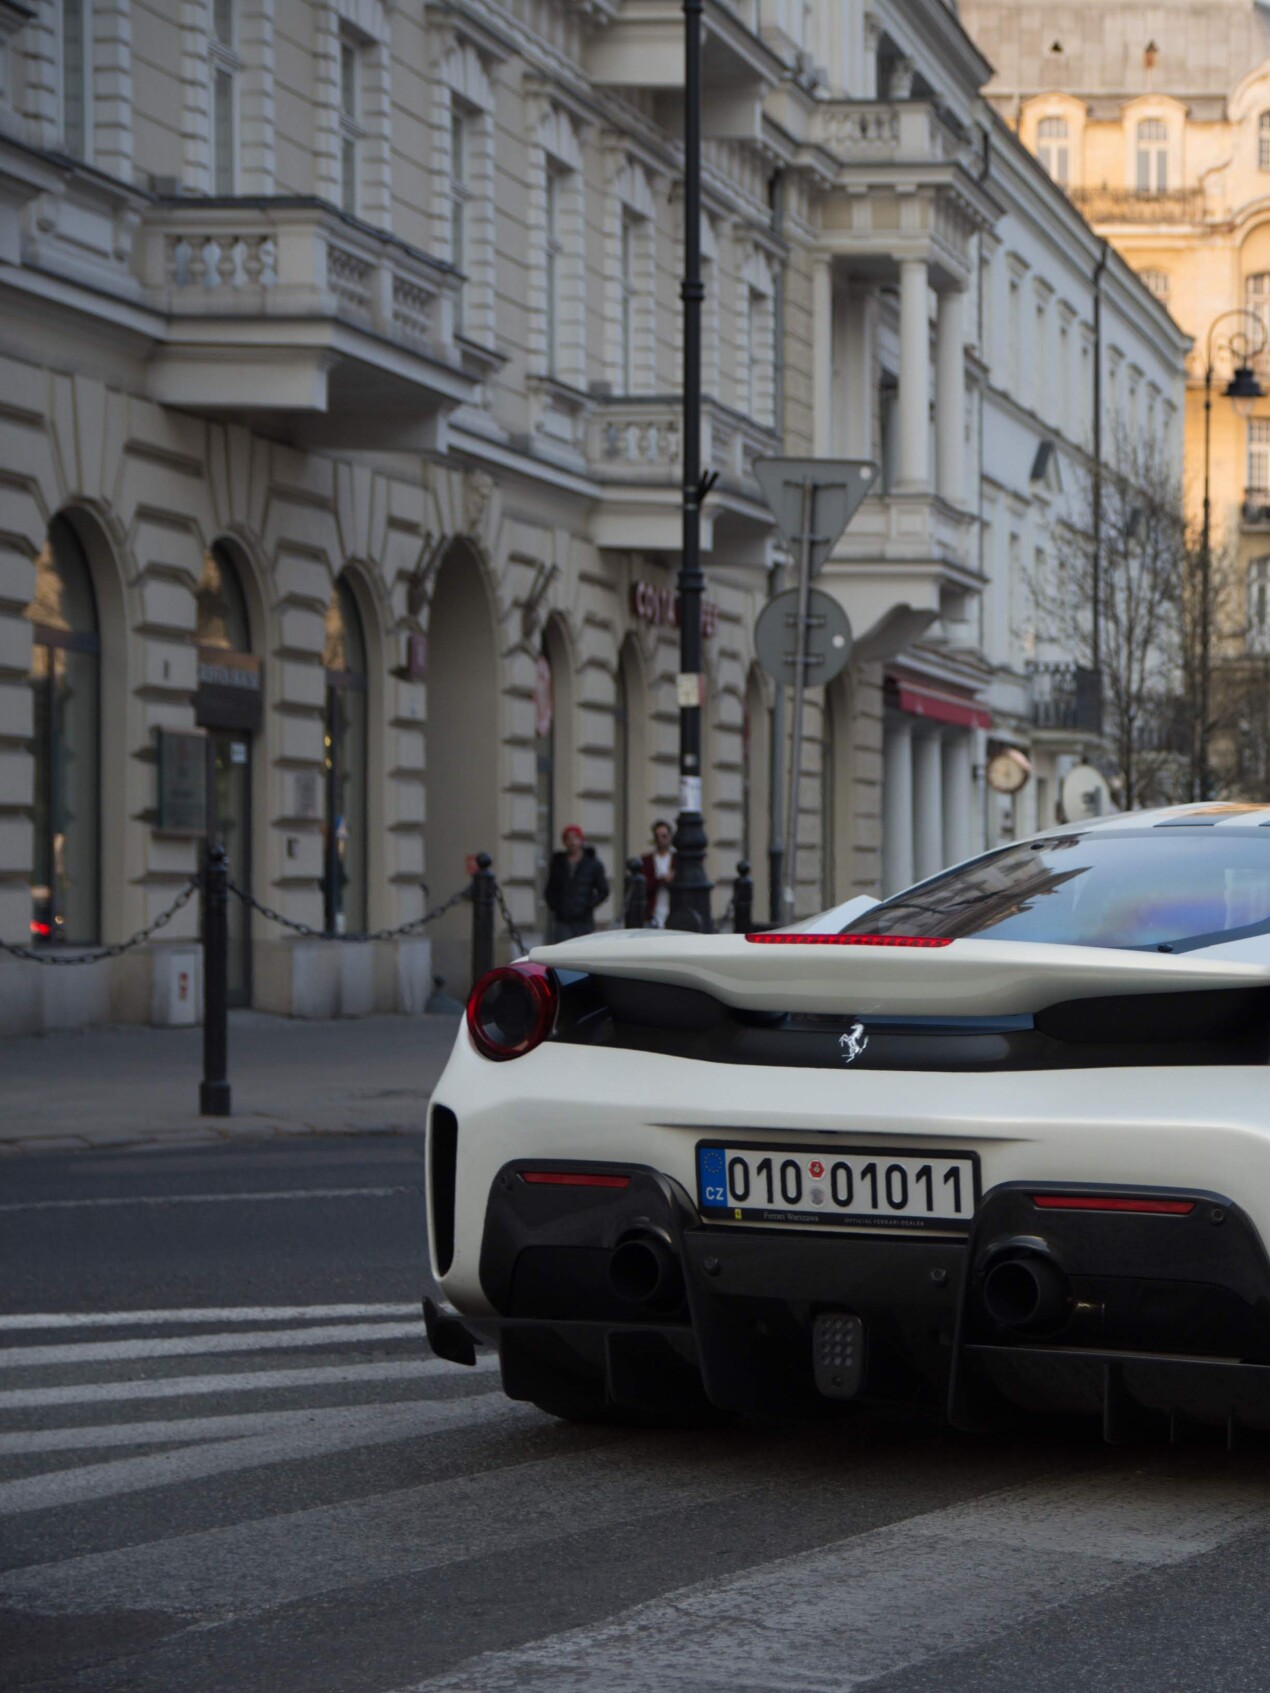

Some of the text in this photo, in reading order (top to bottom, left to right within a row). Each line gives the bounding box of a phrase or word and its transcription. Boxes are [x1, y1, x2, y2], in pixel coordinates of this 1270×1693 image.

[728, 1156, 962, 1214] 010 01011
[705, 1186, 724, 1200] CZ
[763, 1211, 819, 1222] Ferrari Warszawa
